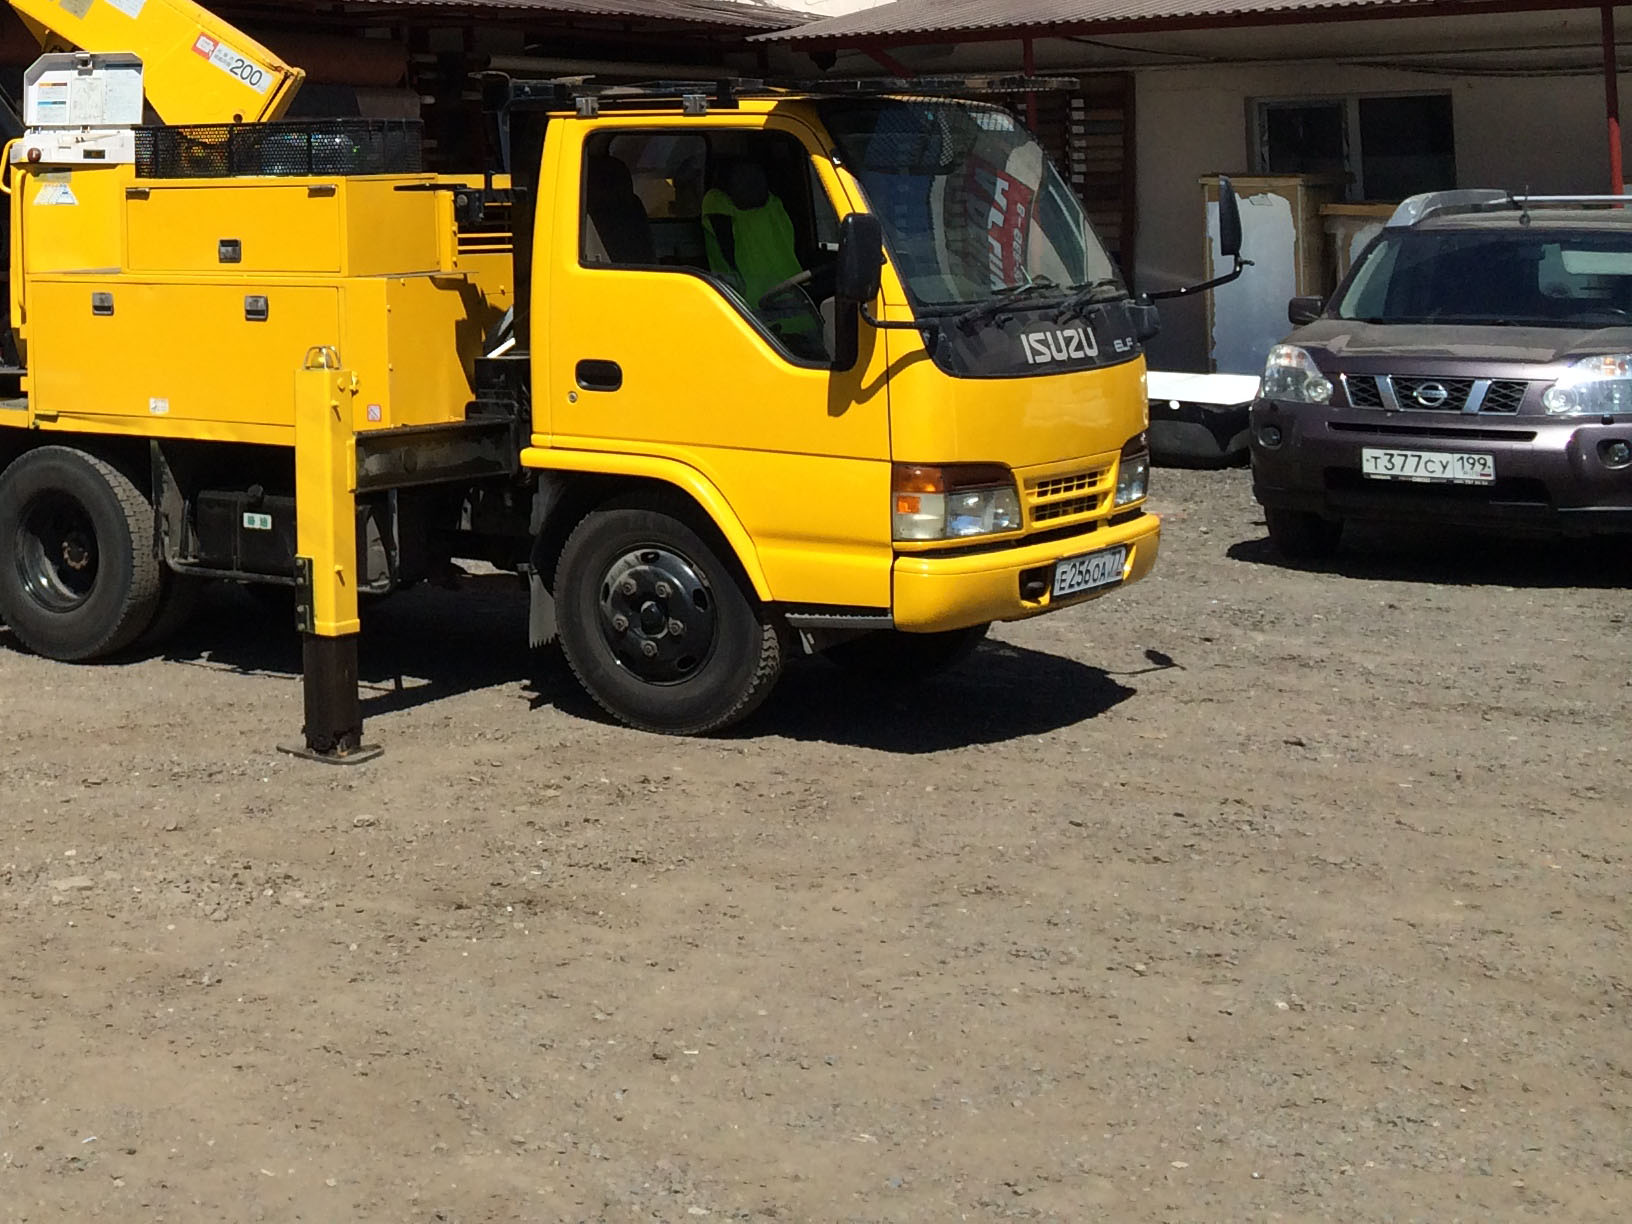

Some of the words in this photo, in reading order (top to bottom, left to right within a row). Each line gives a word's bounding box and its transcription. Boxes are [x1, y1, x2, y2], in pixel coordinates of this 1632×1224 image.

[229, 58, 263, 86] 200
[1020, 327, 1099, 364] ISUZU
[1113, 337, 1134, 353] ELF
